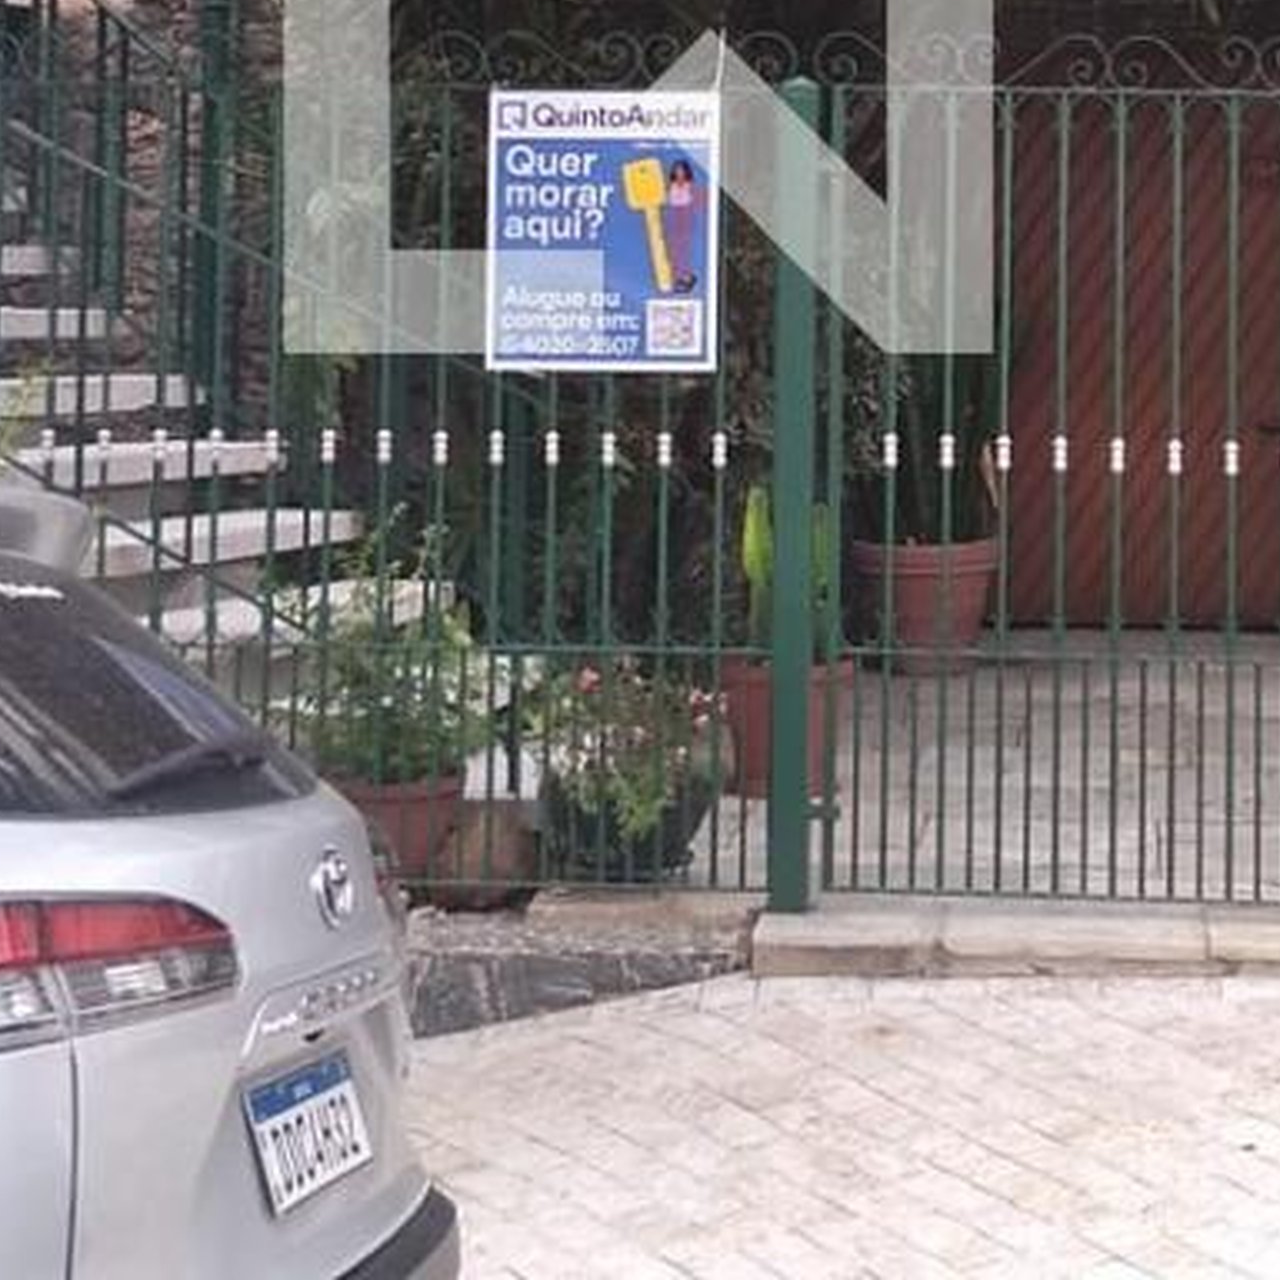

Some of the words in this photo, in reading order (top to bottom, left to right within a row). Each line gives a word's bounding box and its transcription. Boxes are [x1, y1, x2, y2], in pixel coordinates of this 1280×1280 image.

[532, 102, 709, 131] QuintoAndar
[506, 144, 599, 179] Quer
[504, 183, 612, 208] morar
[504, 210, 604, 245] aqui?
[502, 287, 586, 311] Alugue
[590, 291, 621, 308] ou
